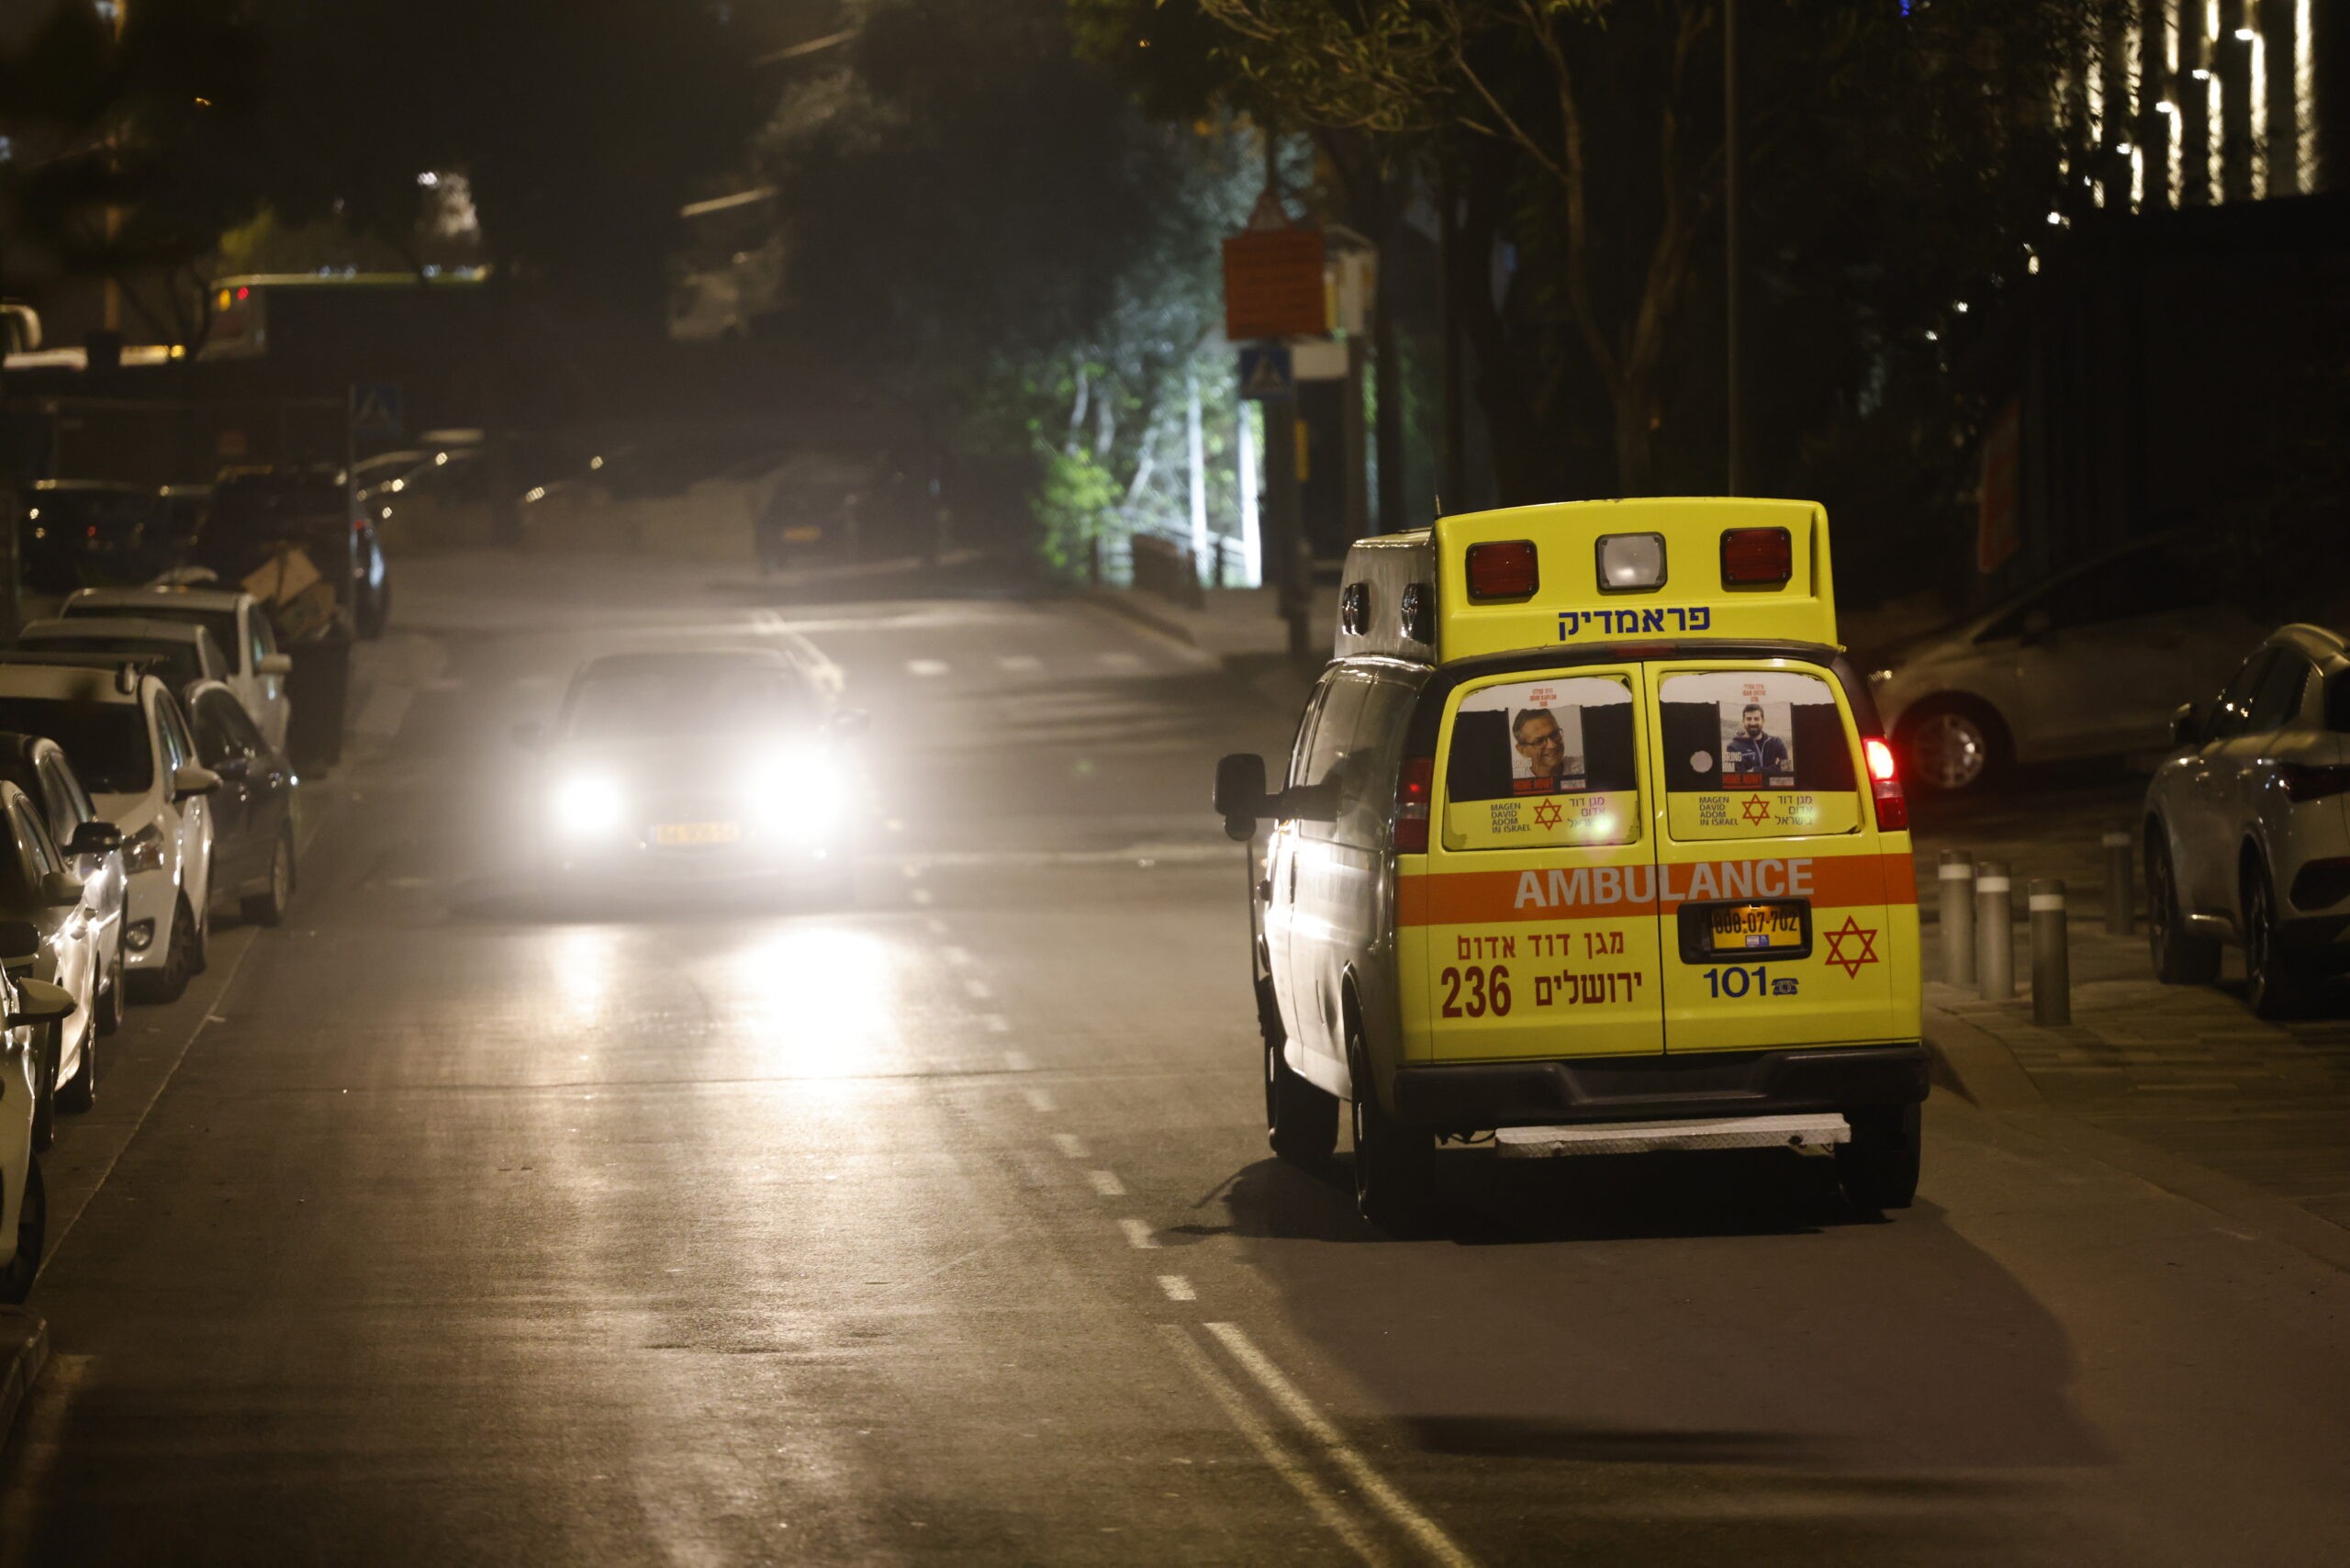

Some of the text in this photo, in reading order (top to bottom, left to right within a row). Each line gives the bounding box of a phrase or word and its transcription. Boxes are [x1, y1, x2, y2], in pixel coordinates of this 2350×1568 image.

[1559, 607, 1710, 641] פראמדיק
[1491, 802, 1521, 811] MAGEN
[1569, 797, 1605, 807] מגן דוד
[1777, 795, 1812, 805] מגן דוד
[1492, 811, 1517, 819] DAVID
[1505, 824, 1530, 833] ISRAEL
[1514, 858, 1814, 909] AMBULANCE
[1457, 932, 1624, 960] מגן דוד אדום
[1441, 964, 1512, 1018] 236
[1535, 969, 1642, 1006] ירושלים
[1704, 966, 1767, 998] 101
